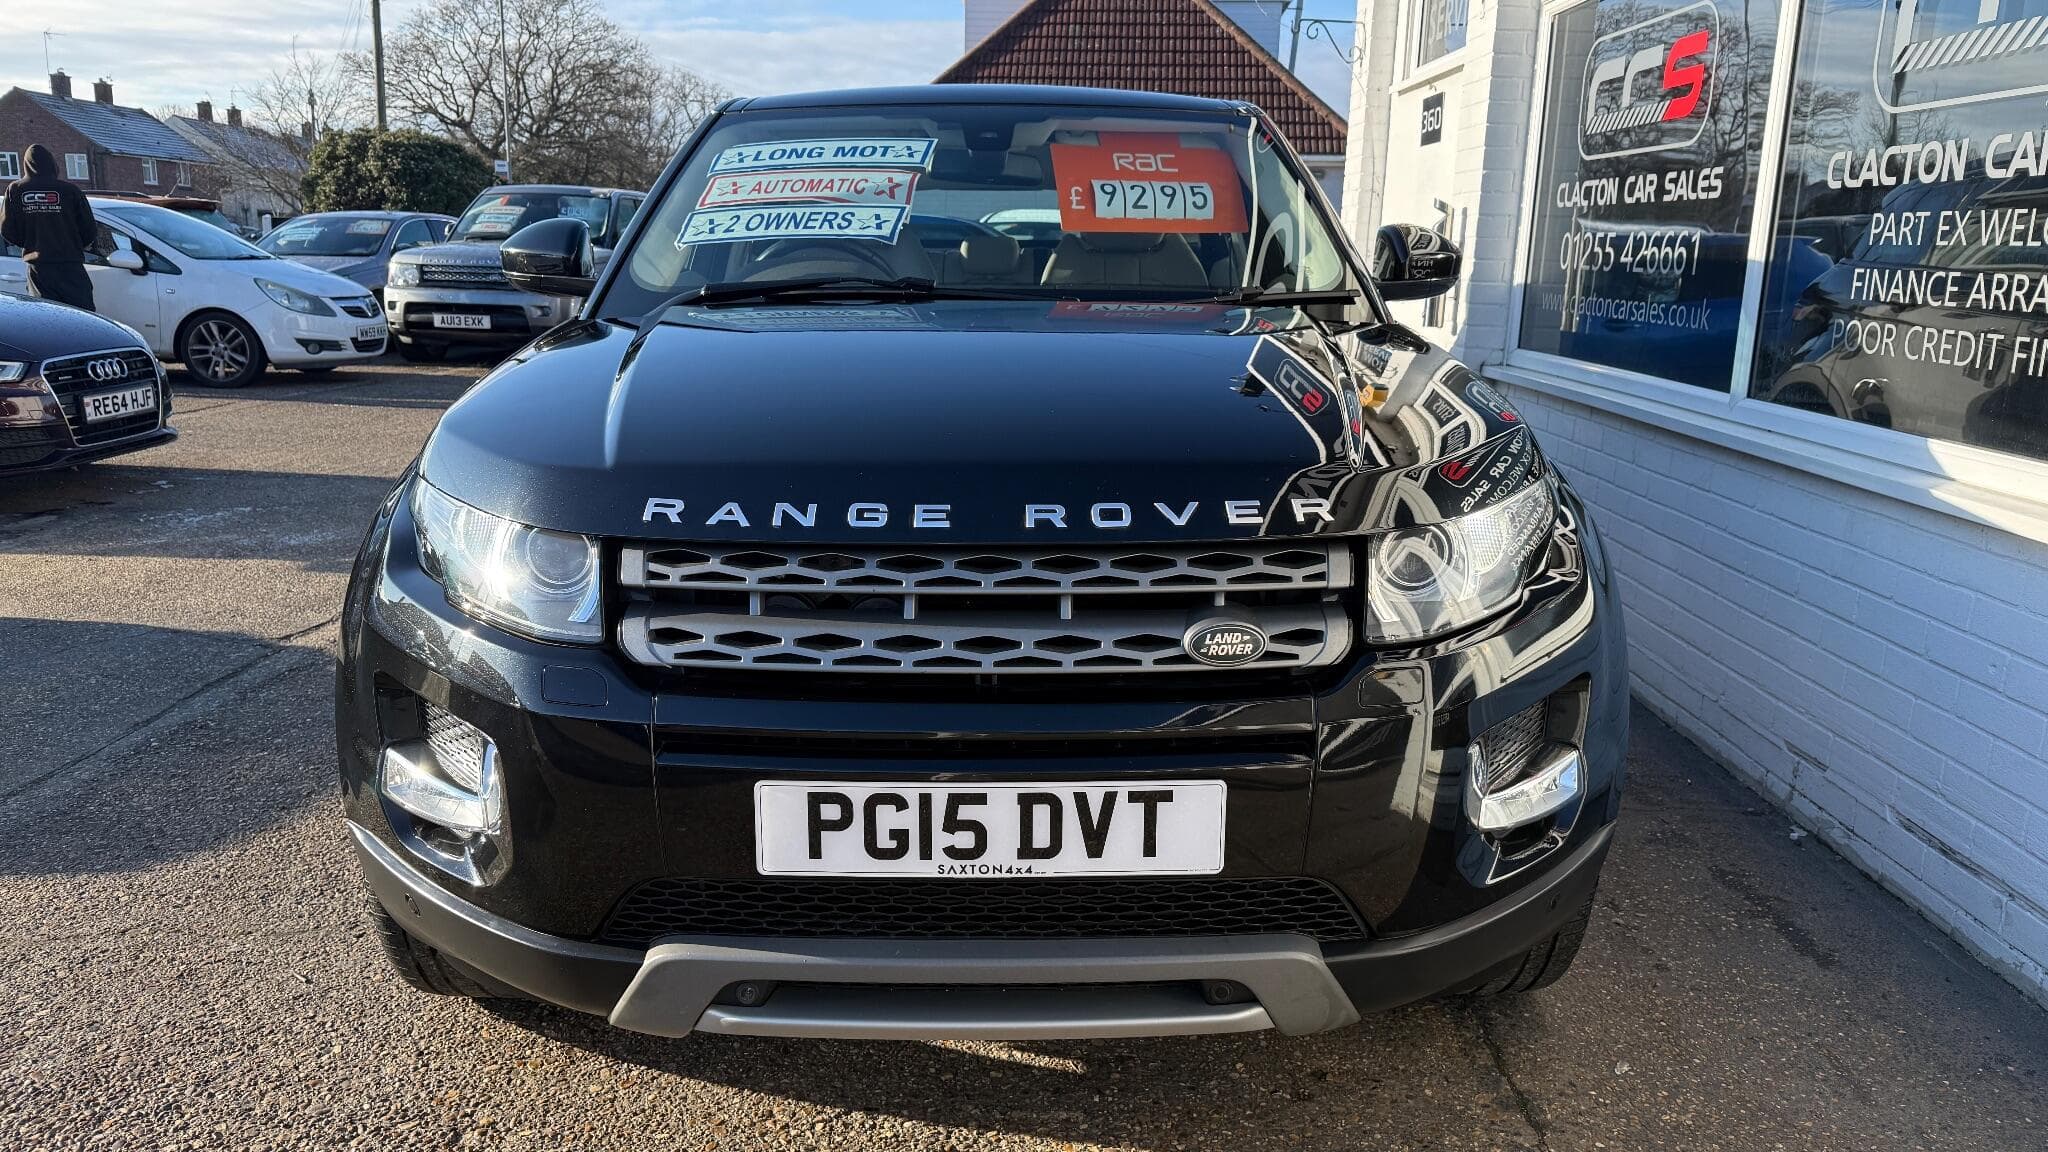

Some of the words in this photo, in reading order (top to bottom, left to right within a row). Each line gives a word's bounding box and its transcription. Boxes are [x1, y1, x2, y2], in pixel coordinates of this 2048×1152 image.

[1586, 29, 1709, 134] CCS
[1422, 106, 1442, 134] 360
[751, 146, 824, 162] LONG
[832, 144, 895, 158] MOT
[1827, 138, 1970, 189] CLACTON
[747, 178, 869, 196] AUTOMATIC
[1069, 186, 1086, 210] £
[1099, 183, 1208, 210] 9295
[1556, 177, 1619, 208] CLACTON
[1624, 173, 1658, 204] CAR
[1663, 166, 1724, 202] SALES
[722, 214, 741, 234] 2
[744, 211, 856, 232] OWNERS
[1868, 211, 1932, 246] PART
[1936, 210, 1972, 246] EX
[1981, 208, 2048, 247] WEL
[1560, 232, 1617, 271] 01255
[1620, 230, 1701, 275] 426661
[1850, 268, 1962, 307] FINANCE
[440, 315, 462, 326] AU13
[464, 316, 484, 327] EXK
[1830, 318, 1897, 357] POOR
[1904, 325, 2005, 371] CREDIT
[93, 394, 129, 417] RE64
[131, 388, 152, 410] HJF
[642, 497, 951, 528] RANGE
[1025, 498, 1335, 528] ROVER
[1208, 643, 1253, 656] ROVER
[807, 791, 989, 861] PG15
[1016, 789, 1174, 860] DVT
